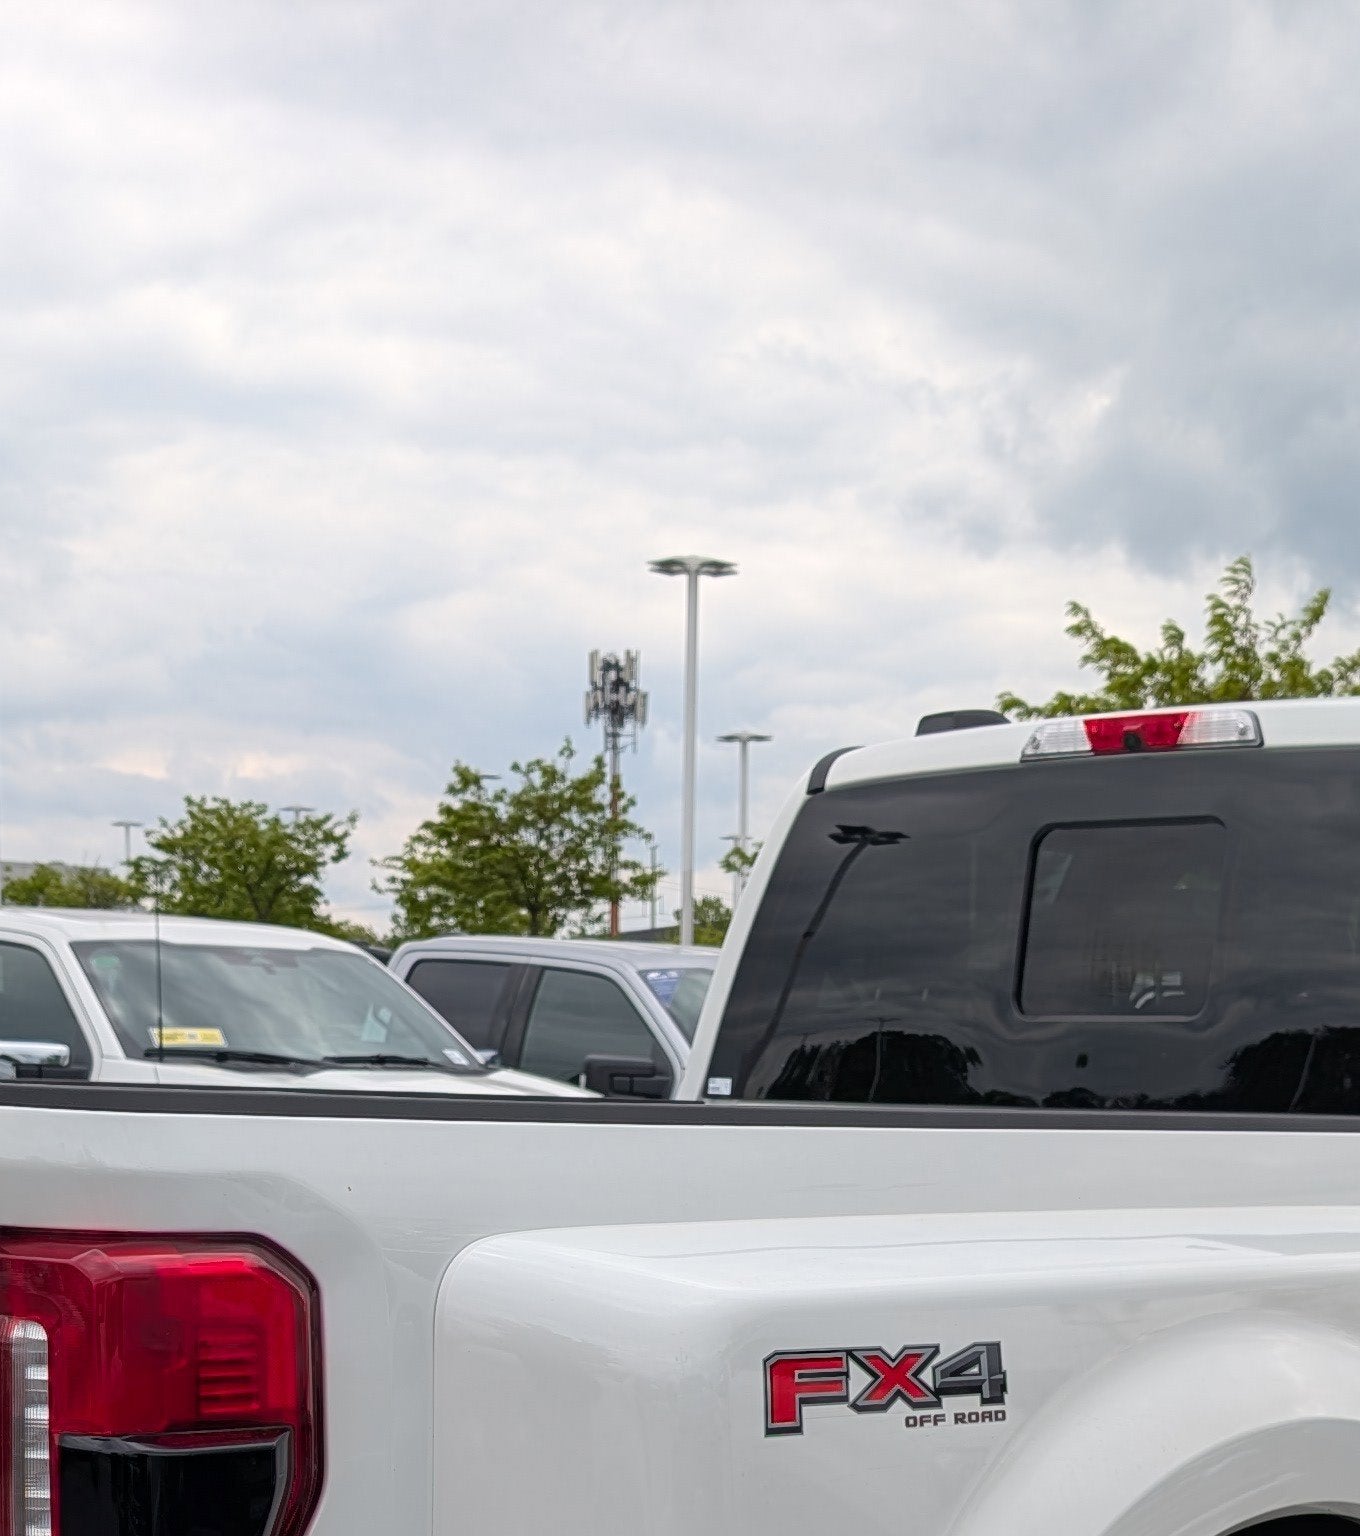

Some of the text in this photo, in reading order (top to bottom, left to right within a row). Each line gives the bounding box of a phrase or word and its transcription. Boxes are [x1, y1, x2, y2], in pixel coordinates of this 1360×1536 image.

[763, 1341, 1008, 1438] FX4
[904, 1409, 1007, 1428] OFF ROAD
